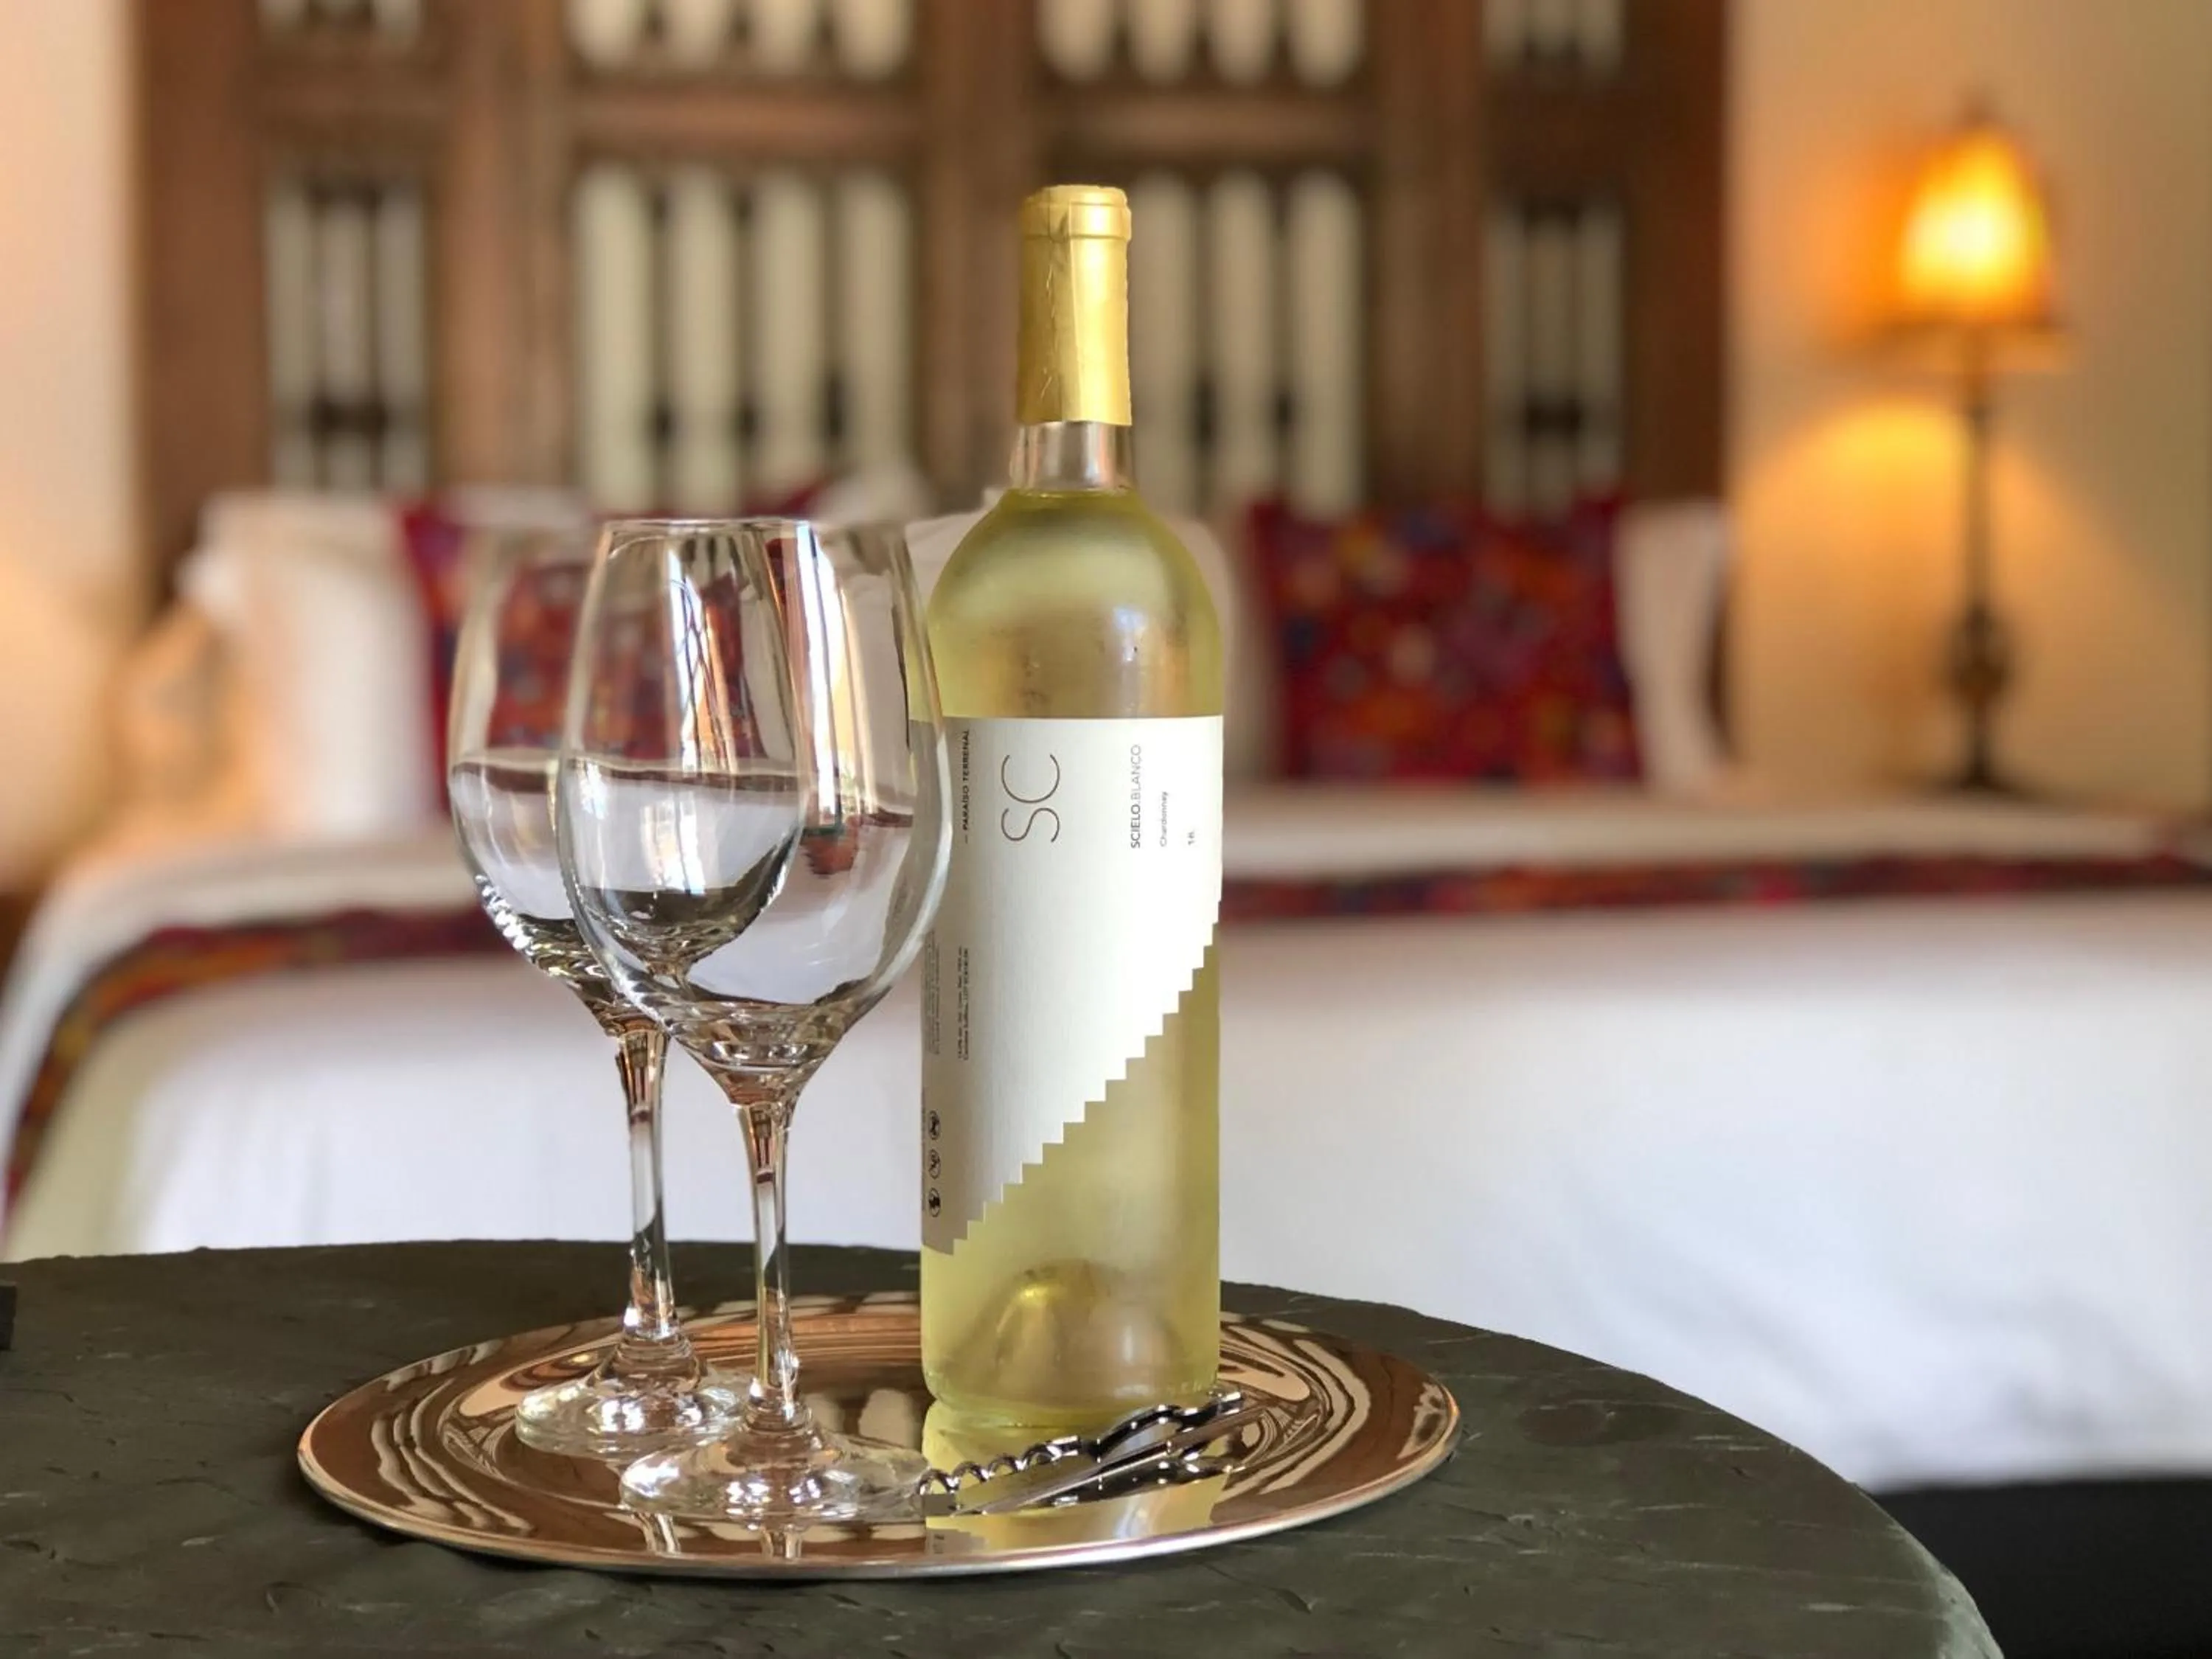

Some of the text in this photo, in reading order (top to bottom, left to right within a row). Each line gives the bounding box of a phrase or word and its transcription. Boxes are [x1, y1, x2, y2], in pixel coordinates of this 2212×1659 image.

[961, 730, 970, 782] TERRENAL
[1001, 754, 1060, 843] SC
[1159, 791, 1169, 847] Chardonnay
